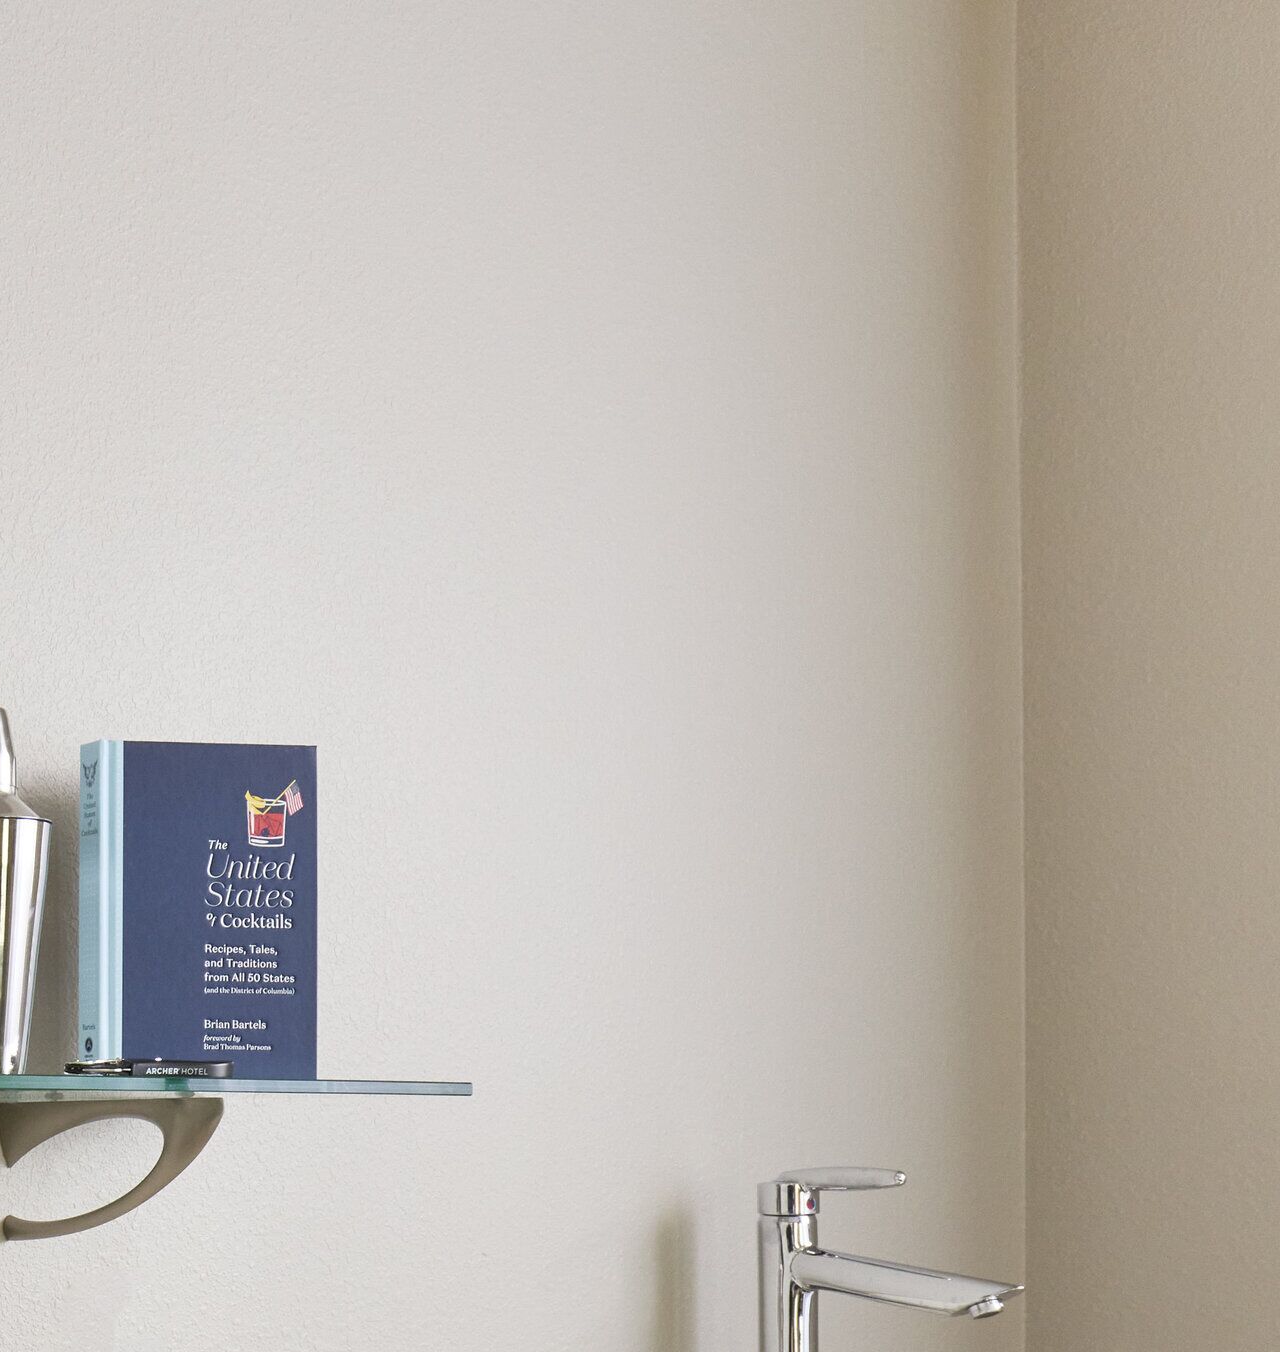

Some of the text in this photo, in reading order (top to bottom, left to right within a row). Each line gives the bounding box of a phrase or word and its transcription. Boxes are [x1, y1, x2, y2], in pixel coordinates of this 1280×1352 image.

[208, 839, 228, 850] The
[207, 853, 295, 880] United
[204, 881, 294, 908] States
[220, 912, 293, 929] Cocktails
[204, 943, 278, 956] Recipes, Tales,
[204, 958, 278, 969] and Traditions
[204, 972, 295, 983] from All 50 States
[263, 987, 295, 995] Columbia)
[204, 1019, 267, 1030] Brian Bartels
[203, 1034, 241, 1043] foreword by
[246, 1043, 272, 1051] Parsons
[146, 1067, 208, 1075] ARCHER HOTEL
